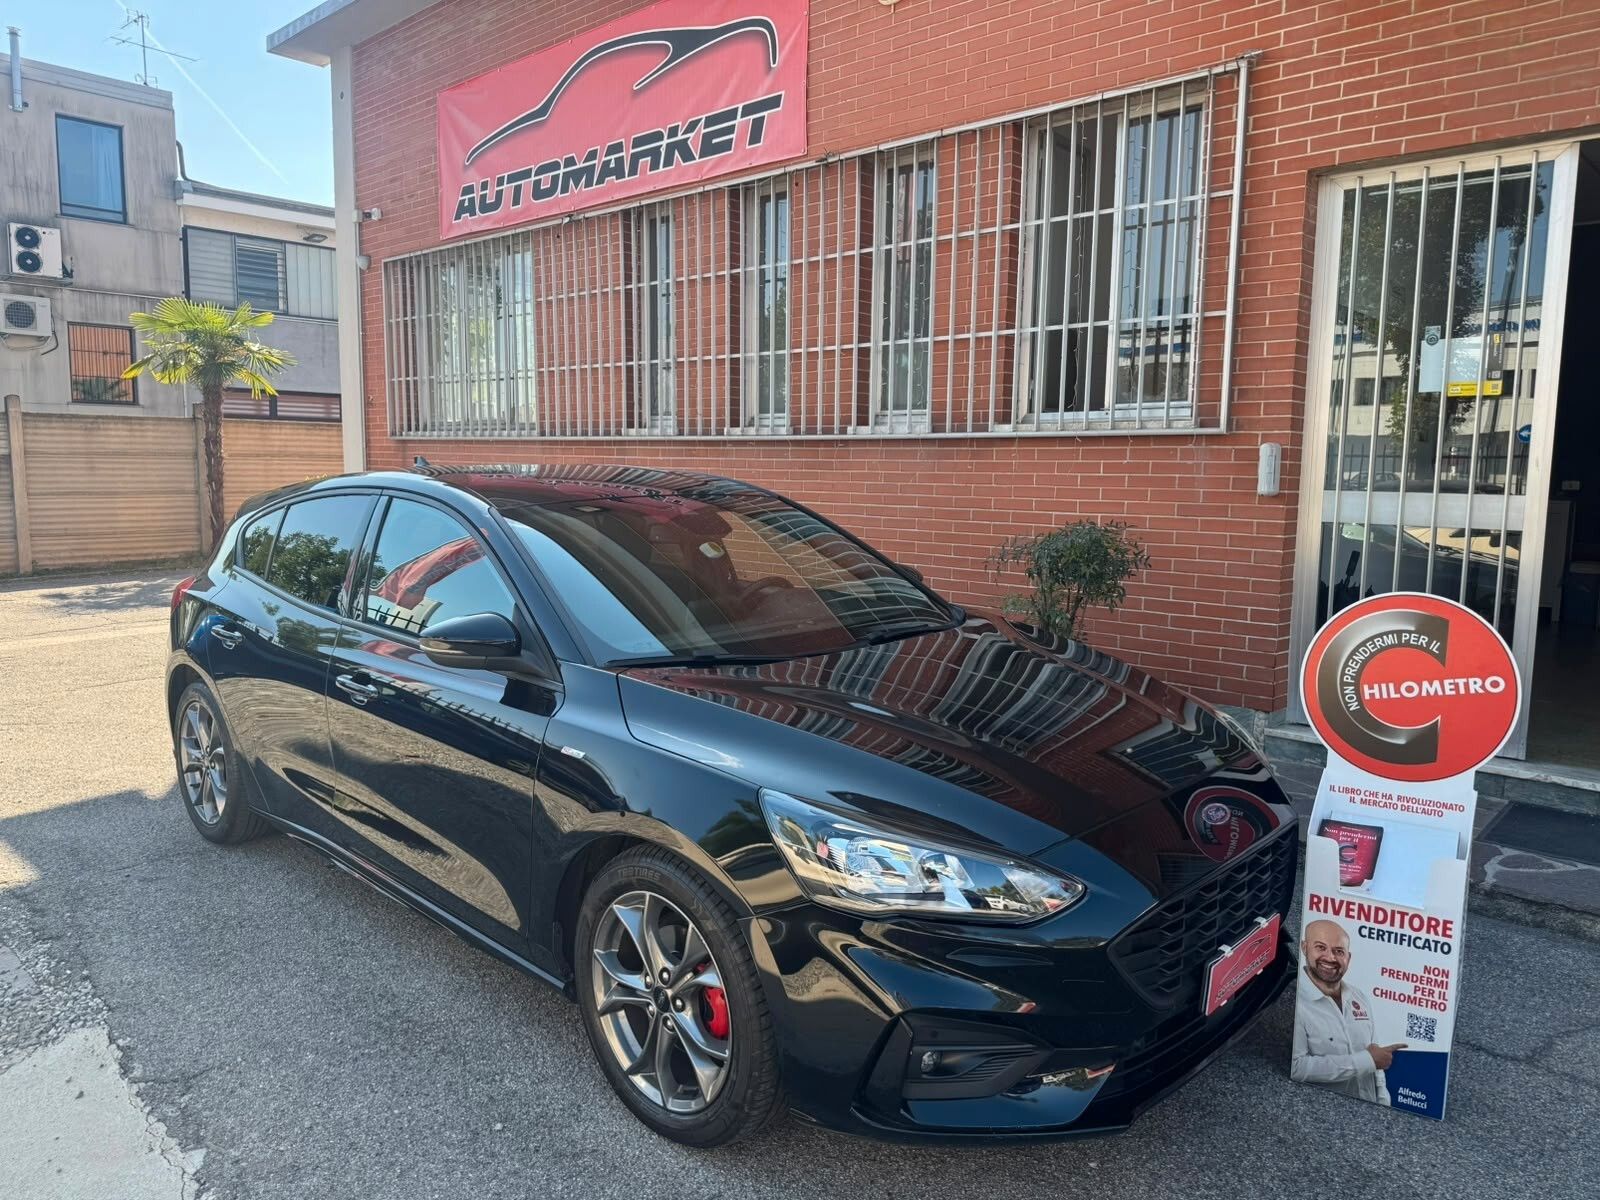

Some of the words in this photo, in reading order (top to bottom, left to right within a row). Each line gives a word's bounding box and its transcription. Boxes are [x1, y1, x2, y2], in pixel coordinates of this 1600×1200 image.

[453, 91, 785, 223] AUTOMARKET
[1401, 632, 1429, 647] PER
[1429, 640, 1441, 654] IL
[1344, 632, 1398, 683] PRENDERMI
[1343, 686, 1360, 711] NON
[1329, 784, 1337, 793] IL
[1338, 786, 1362, 796] LIBRO
[1363, 789, 1380, 799] CHE
[1381, 792, 1394, 801] HA
[1396, 795, 1466, 813] RIVOLUZIONATO
[1349, 796, 1356, 804] IL
[1359, 797, 1399, 811] MERCATO
[1400, 803, 1444, 818] DELL'AUTO
[1308, 893, 1454, 939] RIVENDITORE
[1357, 925, 1453, 956] CERTIFICATO
[1380, 966, 1449, 991] PRENDERMI
[1423, 964, 1450, 979] NON
[1372, 987, 1447, 1013] CHILOMETRO
[1413, 984, 1436, 1000] PER
[1437, 991, 1449, 1002] IL
[1397, 1086, 1427, 1101] Alfredo
[1397, 1095, 1428, 1110] Bellucci
